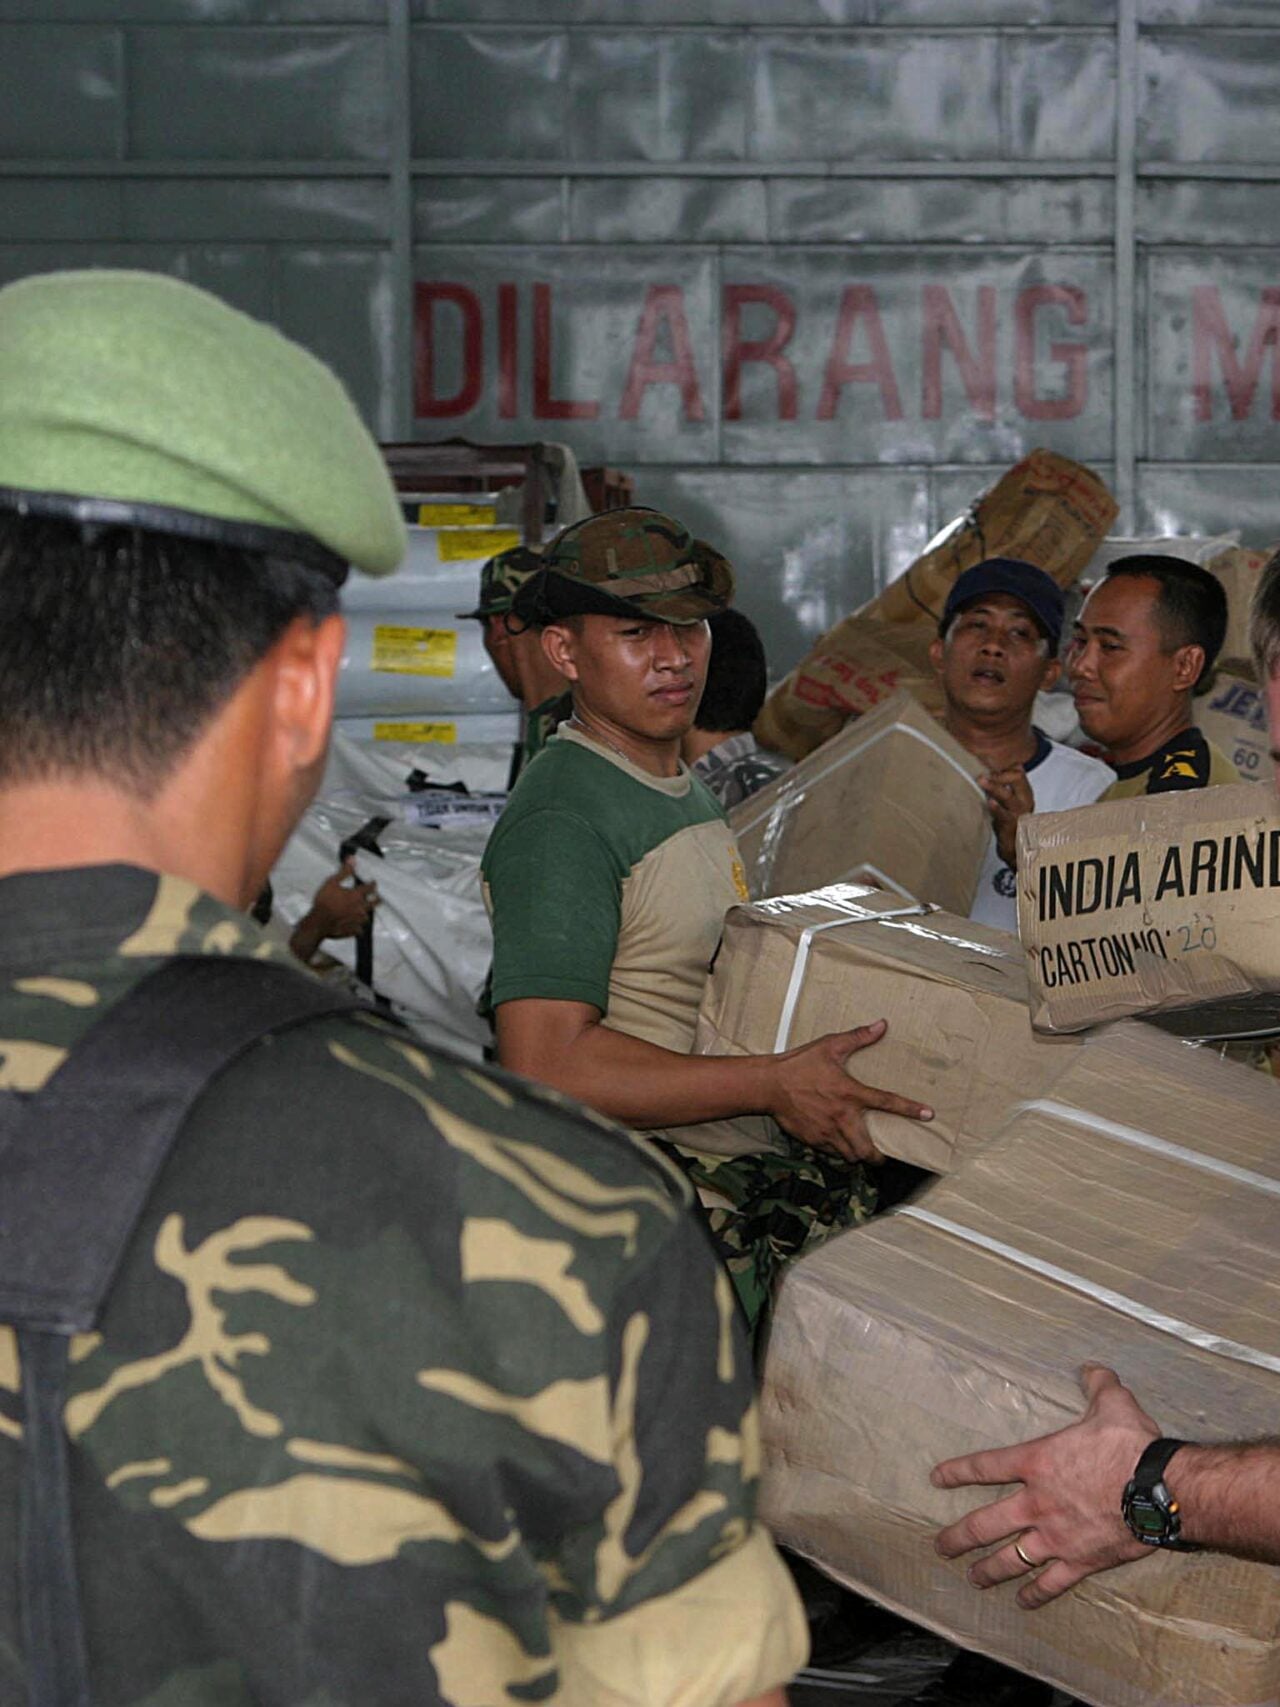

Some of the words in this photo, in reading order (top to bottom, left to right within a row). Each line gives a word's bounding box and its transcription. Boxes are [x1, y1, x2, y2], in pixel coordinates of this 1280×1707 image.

[413, 282, 1089, 421] DILARANG
[1233, 748, 1260, 770] 60
[1038, 850, 1142, 923] INDIA
[1040, 933, 1136, 989] CARTON
